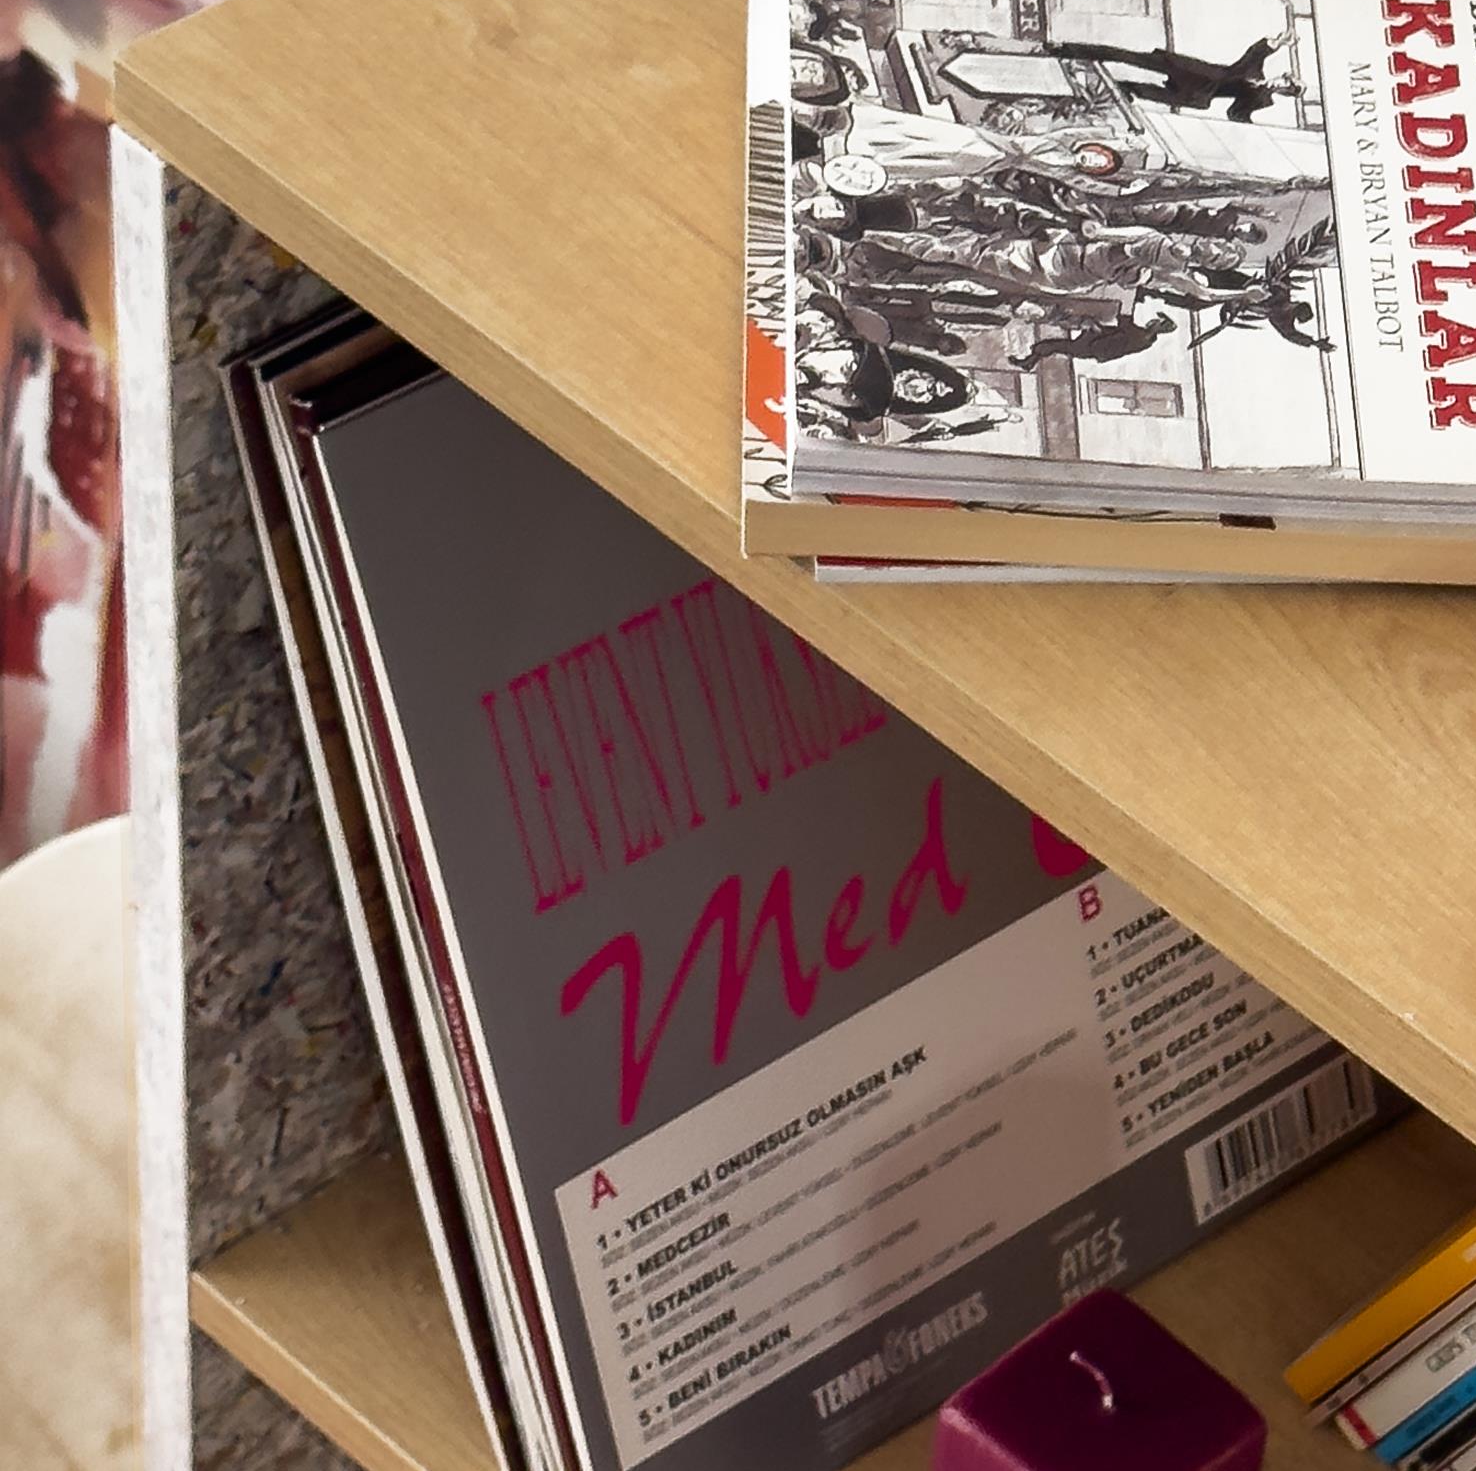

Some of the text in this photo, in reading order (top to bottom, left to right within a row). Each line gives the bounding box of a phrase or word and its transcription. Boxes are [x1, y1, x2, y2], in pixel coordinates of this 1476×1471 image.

[1347, 61, 1379, 133] MARY
[1359, 162, 1393, 246] BRYAN
[1370, 254, 1404, 352] TALBOT
[1078, 884, 1103, 923] B
[560, 775, 970, 1127] Med
[624, 1186, 688, 1233] YETER
[715, 1117, 804, 1181] ONURSUZ
[806, 1069, 887, 1128] OLMASIN
[891, 1045, 928, 1080] AŞK
[591, 1167, 618, 1211] A
[656, 1308, 738, 1366] KADINIM
[715, 1322, 792, 1381] BIRAKIN
